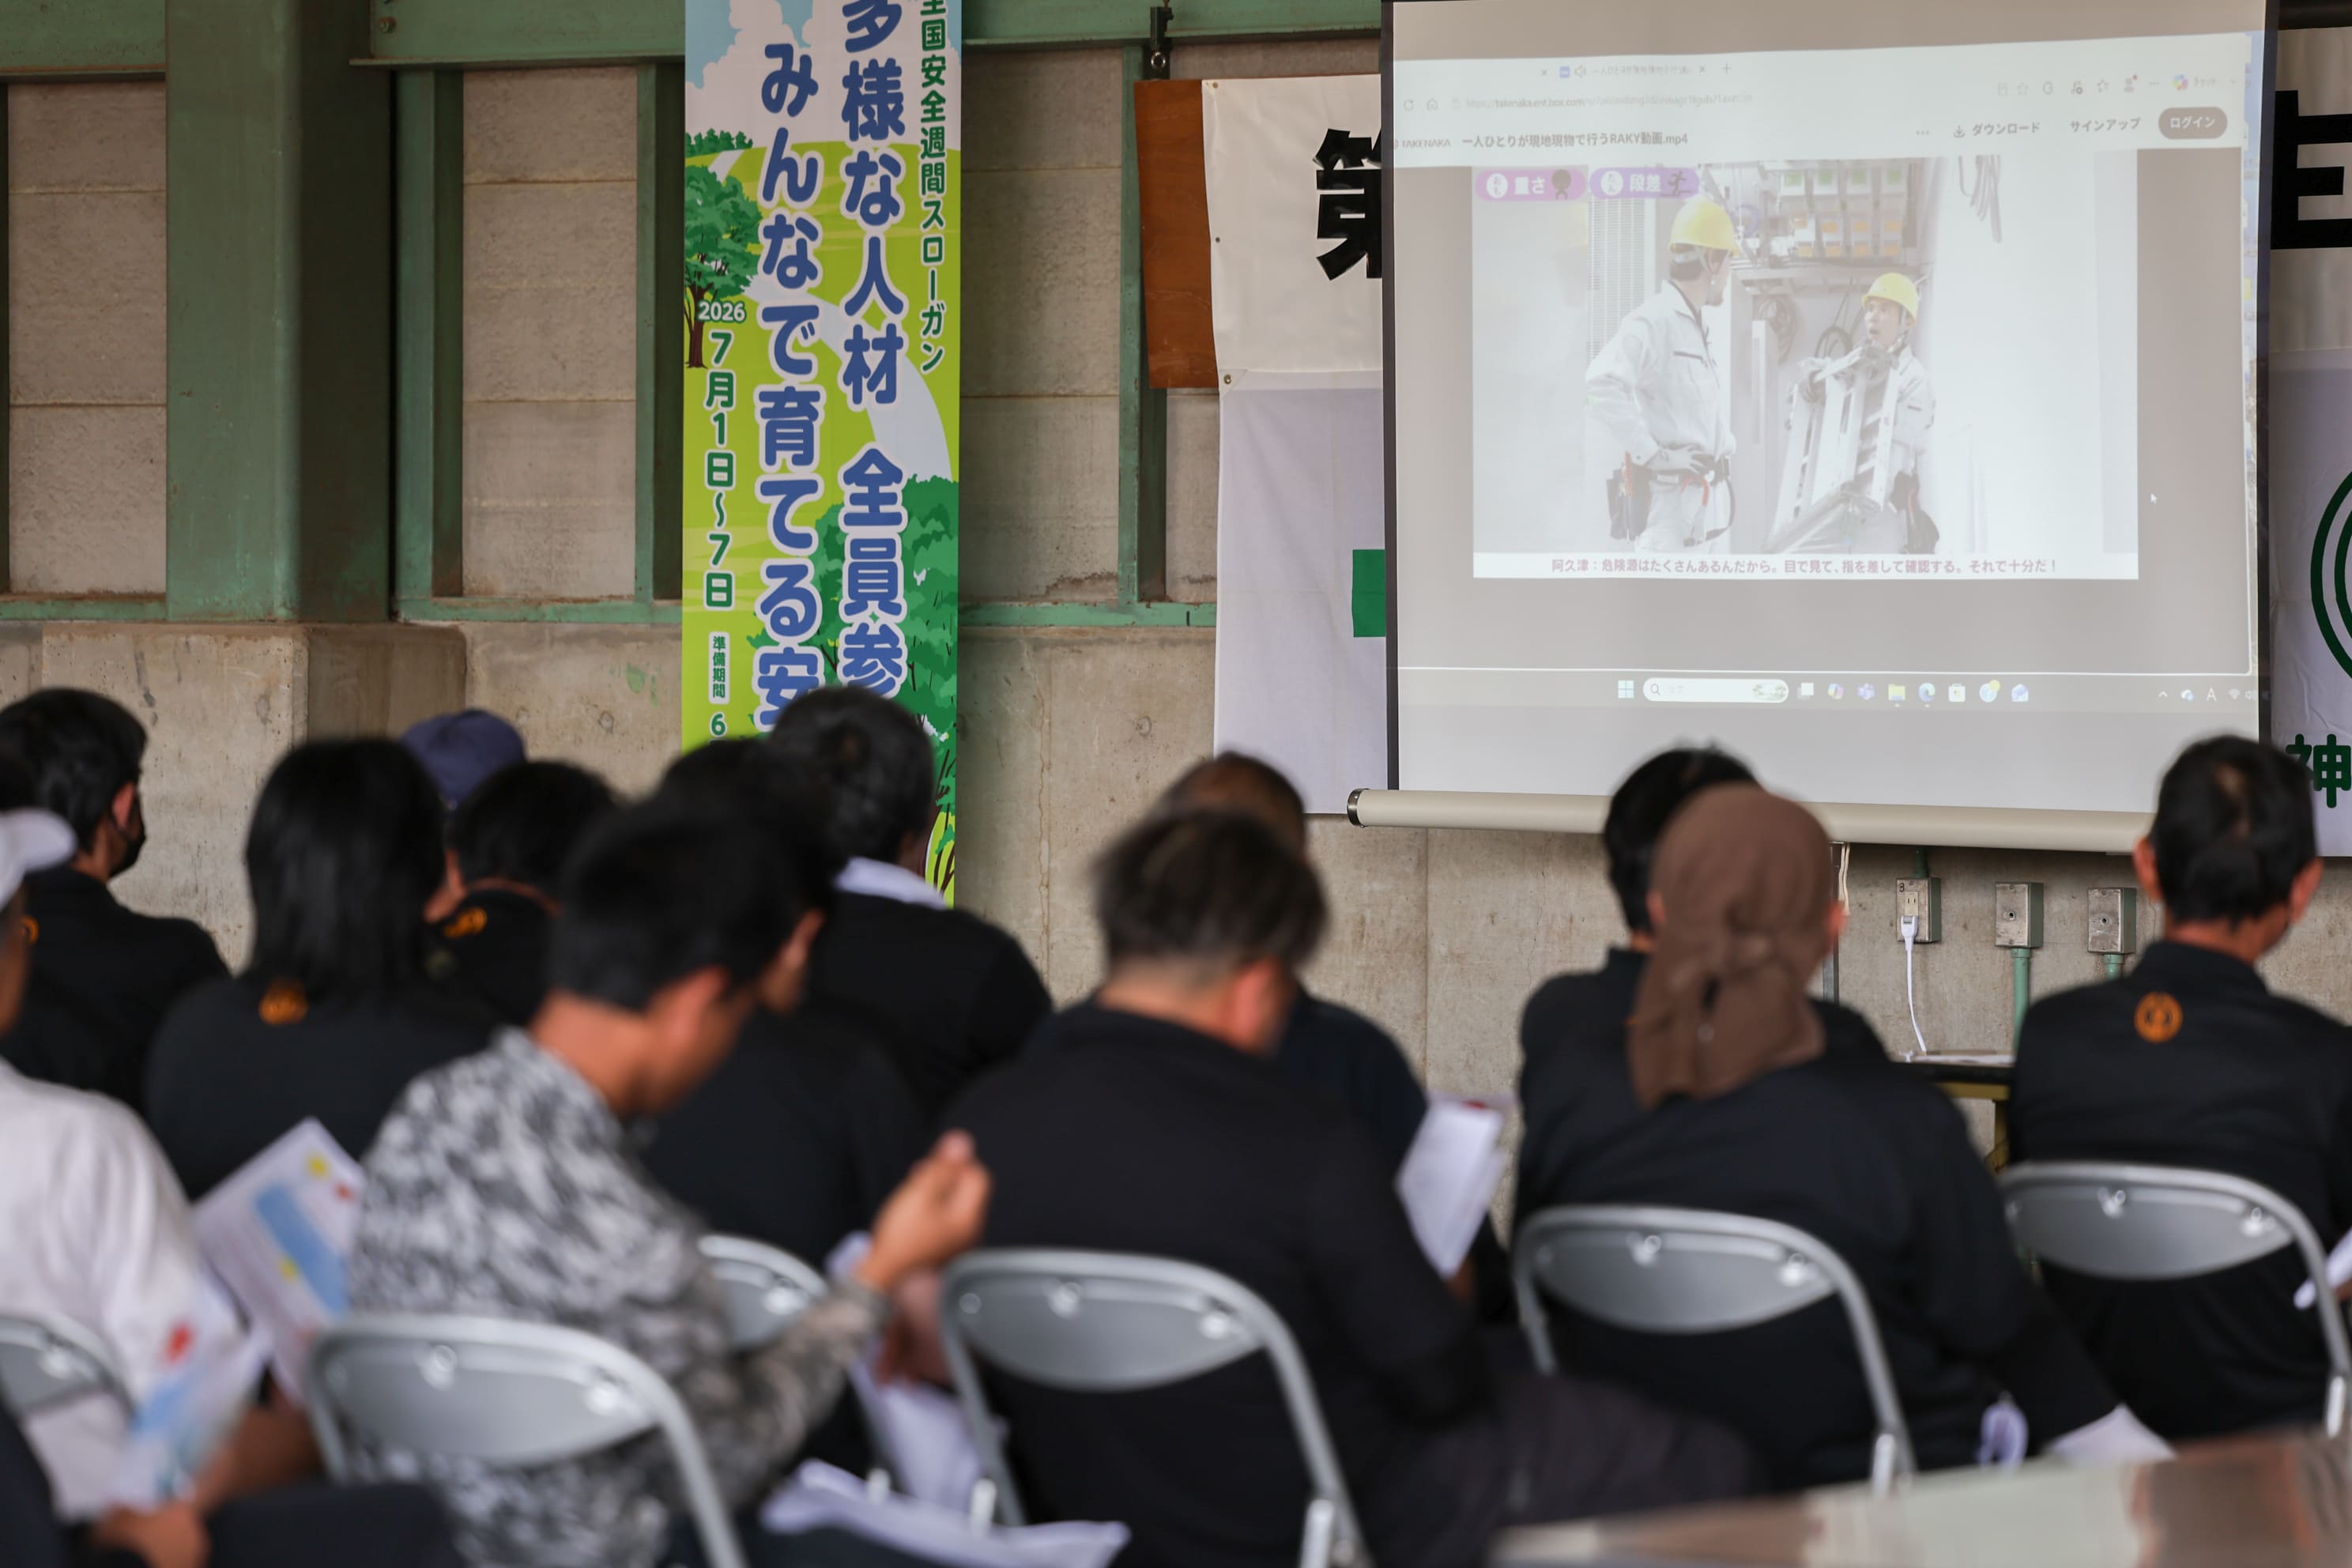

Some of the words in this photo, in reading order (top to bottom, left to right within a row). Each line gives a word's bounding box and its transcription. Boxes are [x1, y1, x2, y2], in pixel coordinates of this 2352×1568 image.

[1972, 122, 2041, 137] ダウンロード
[2070, 118, 2142, 133] サインアップ
[2169, 116, 2216, 130] ログイン
[1462, 131, 1688, 148] 一人ひとりが現地現物で行うRAKY動画.mp4
[1630, 173, 1661, 193] 段差
[842, 0, 906, 404] 多様な人材
[697, 301, 746, 322] 2026
[757, 43, 821, 726] みんなで育てる安
[713, 636, 726, 698] 準備期間
[2206, 688, 2217, 702] A
[2286, 733, 2352, 808] 神
